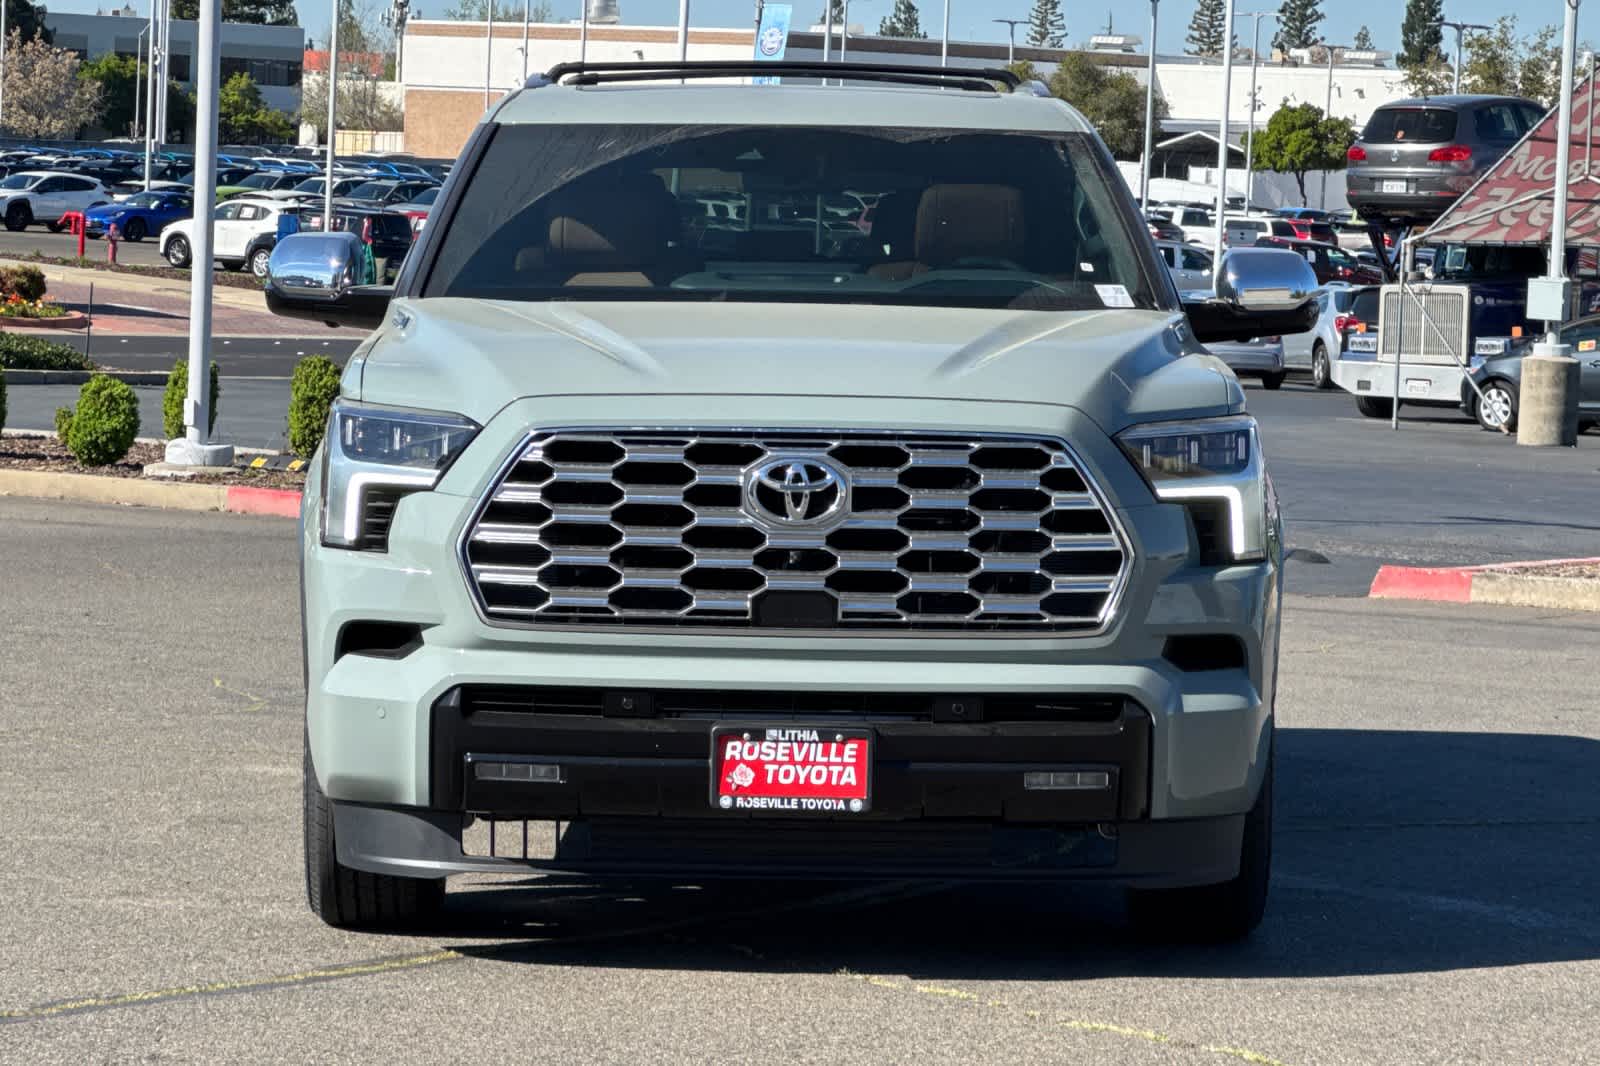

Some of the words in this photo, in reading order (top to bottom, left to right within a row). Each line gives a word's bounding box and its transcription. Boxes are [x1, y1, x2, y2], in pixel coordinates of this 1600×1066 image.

[779, 729, 819, 742] LITHIA
[725, 741, 858, 763] ROSEVILLE
[764, 764, 857, 786] TOYOTA
[736, 797, 799, 809] ROSEVILLE
[801, 798, 846, 810] TOYOTA
